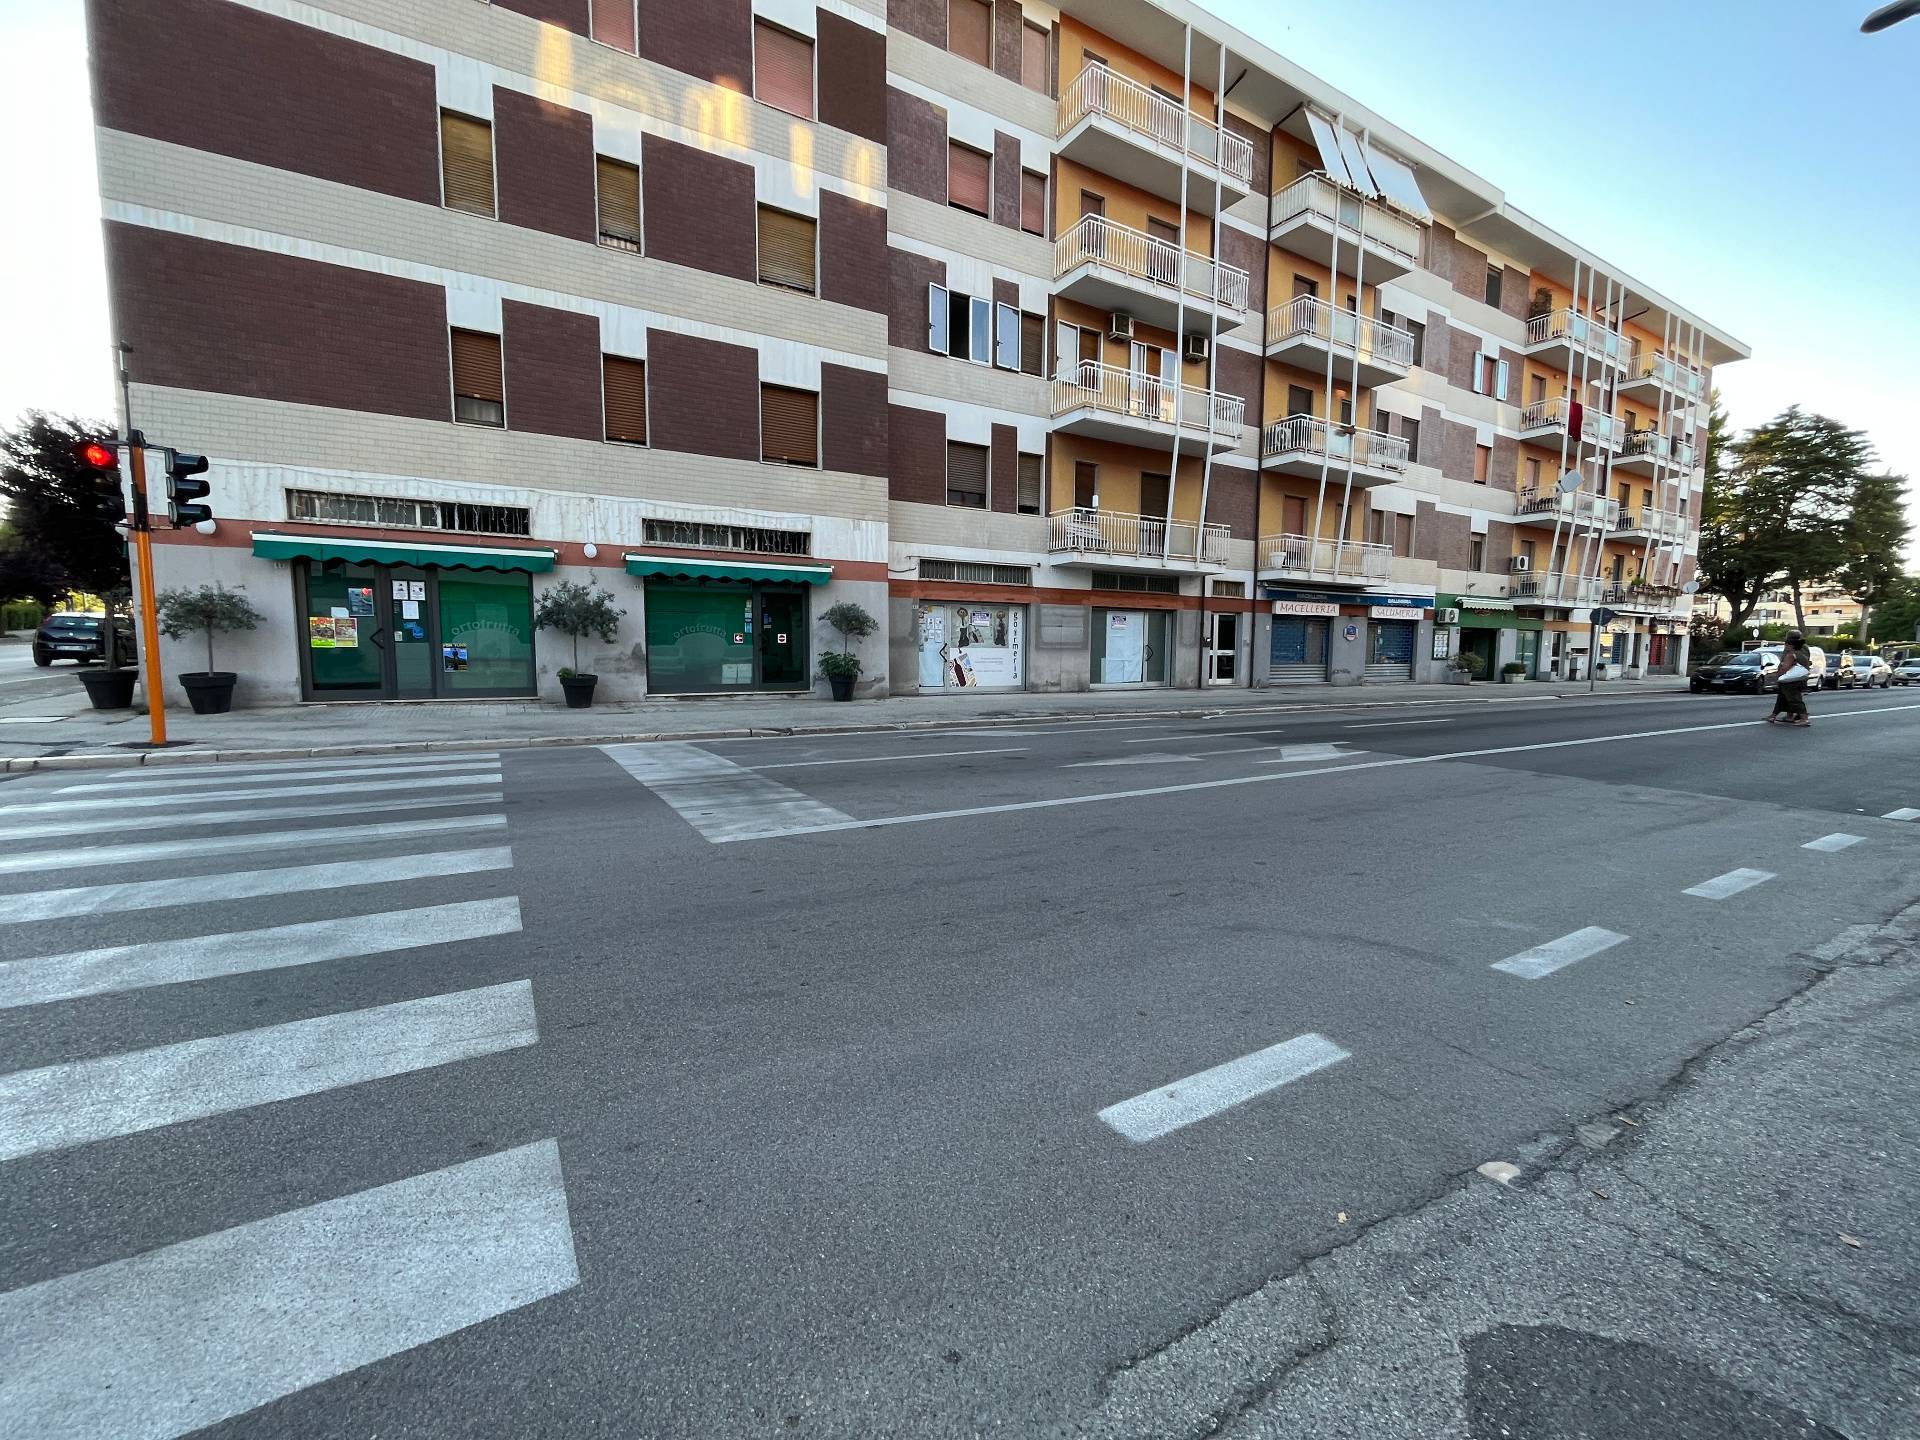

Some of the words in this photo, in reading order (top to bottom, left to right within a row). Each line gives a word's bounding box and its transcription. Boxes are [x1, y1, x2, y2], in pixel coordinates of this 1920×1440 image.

[1280, 602, 1337, 614] MACELLERIA
[1375, 607, 1419, 618] SALUMERIA
[673, 623, 727, 639] ortofrutta
